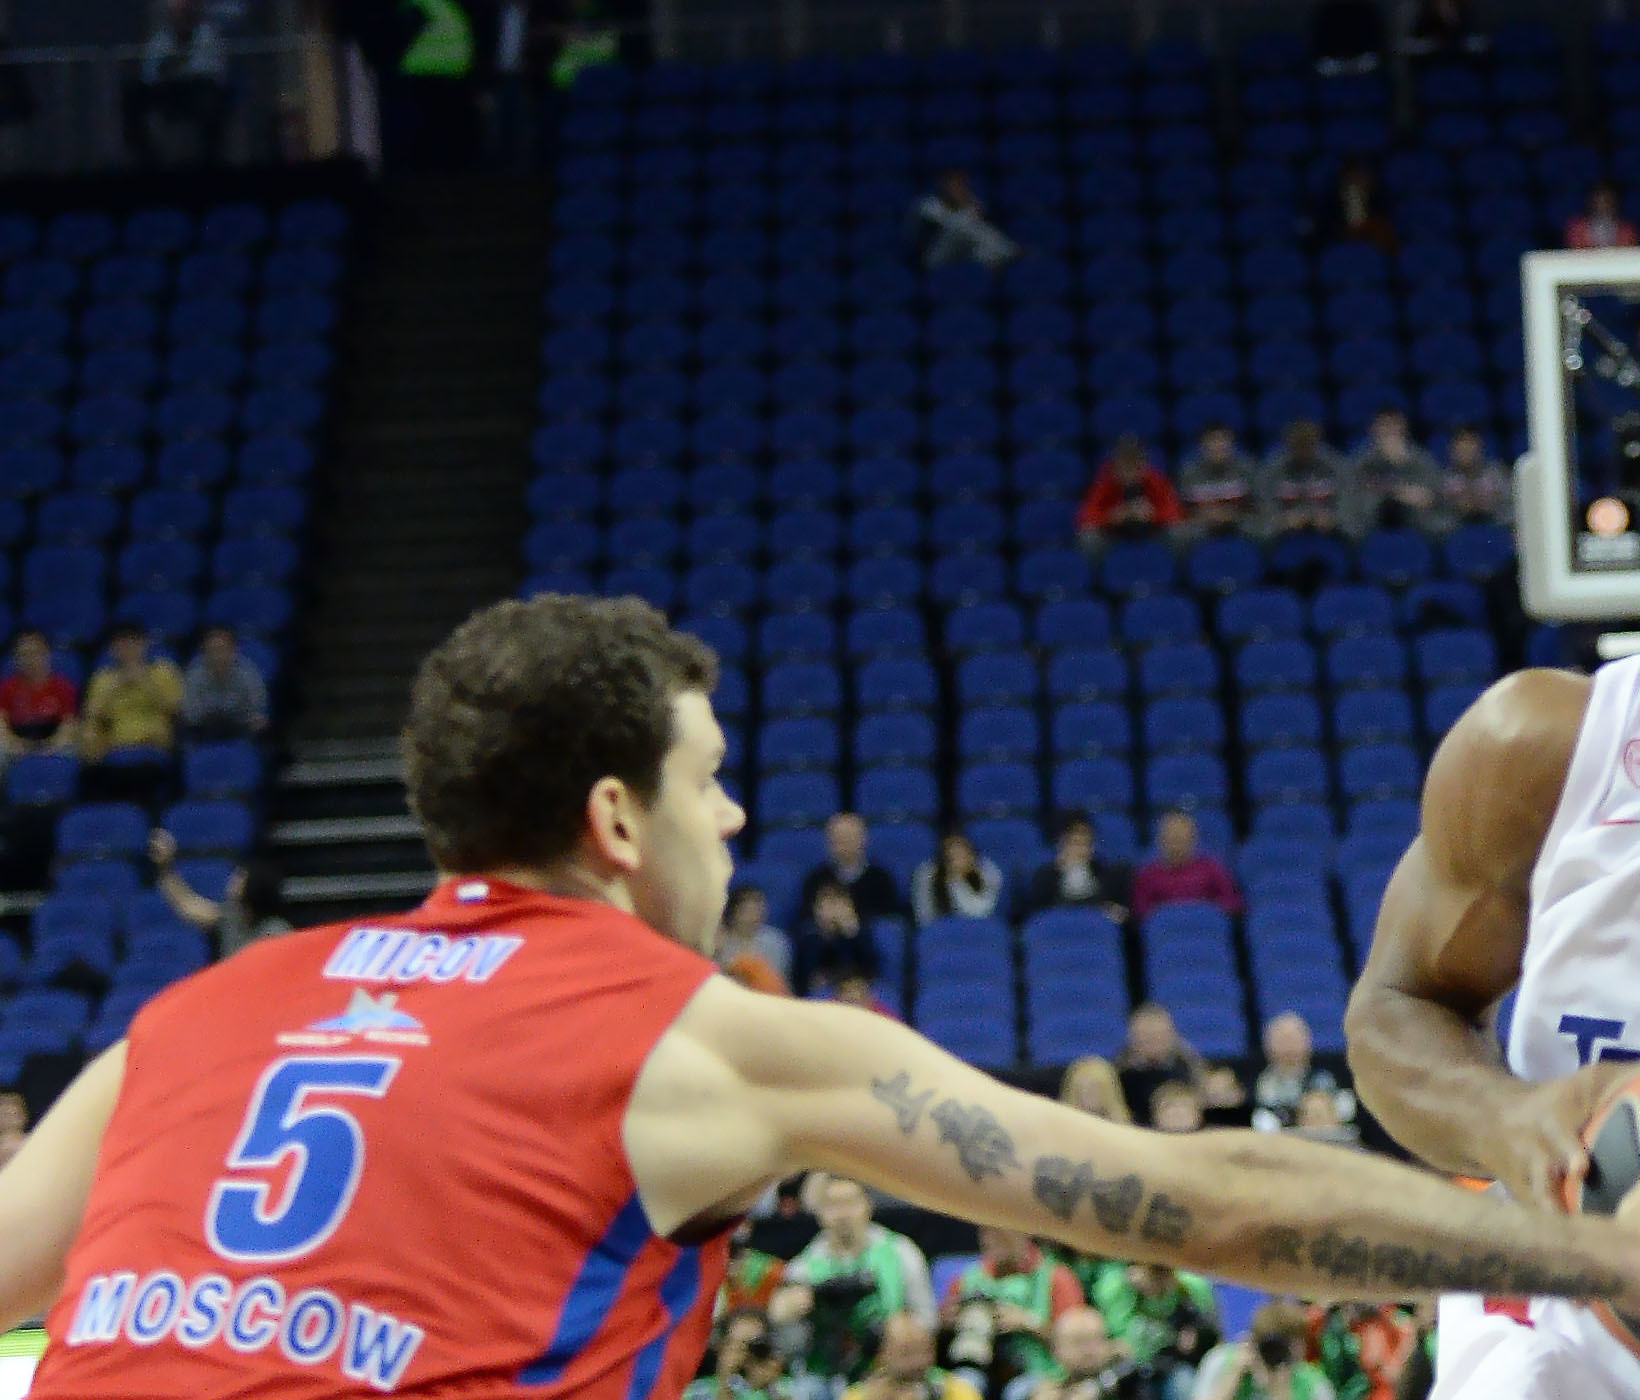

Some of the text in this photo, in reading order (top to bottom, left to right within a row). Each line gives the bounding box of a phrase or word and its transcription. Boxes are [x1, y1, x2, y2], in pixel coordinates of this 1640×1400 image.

[321, 927, 525, 983] MICOV
[204, 1055, 402, 1264] 5
[66, 1271, 424, 1393] MOSCOW
